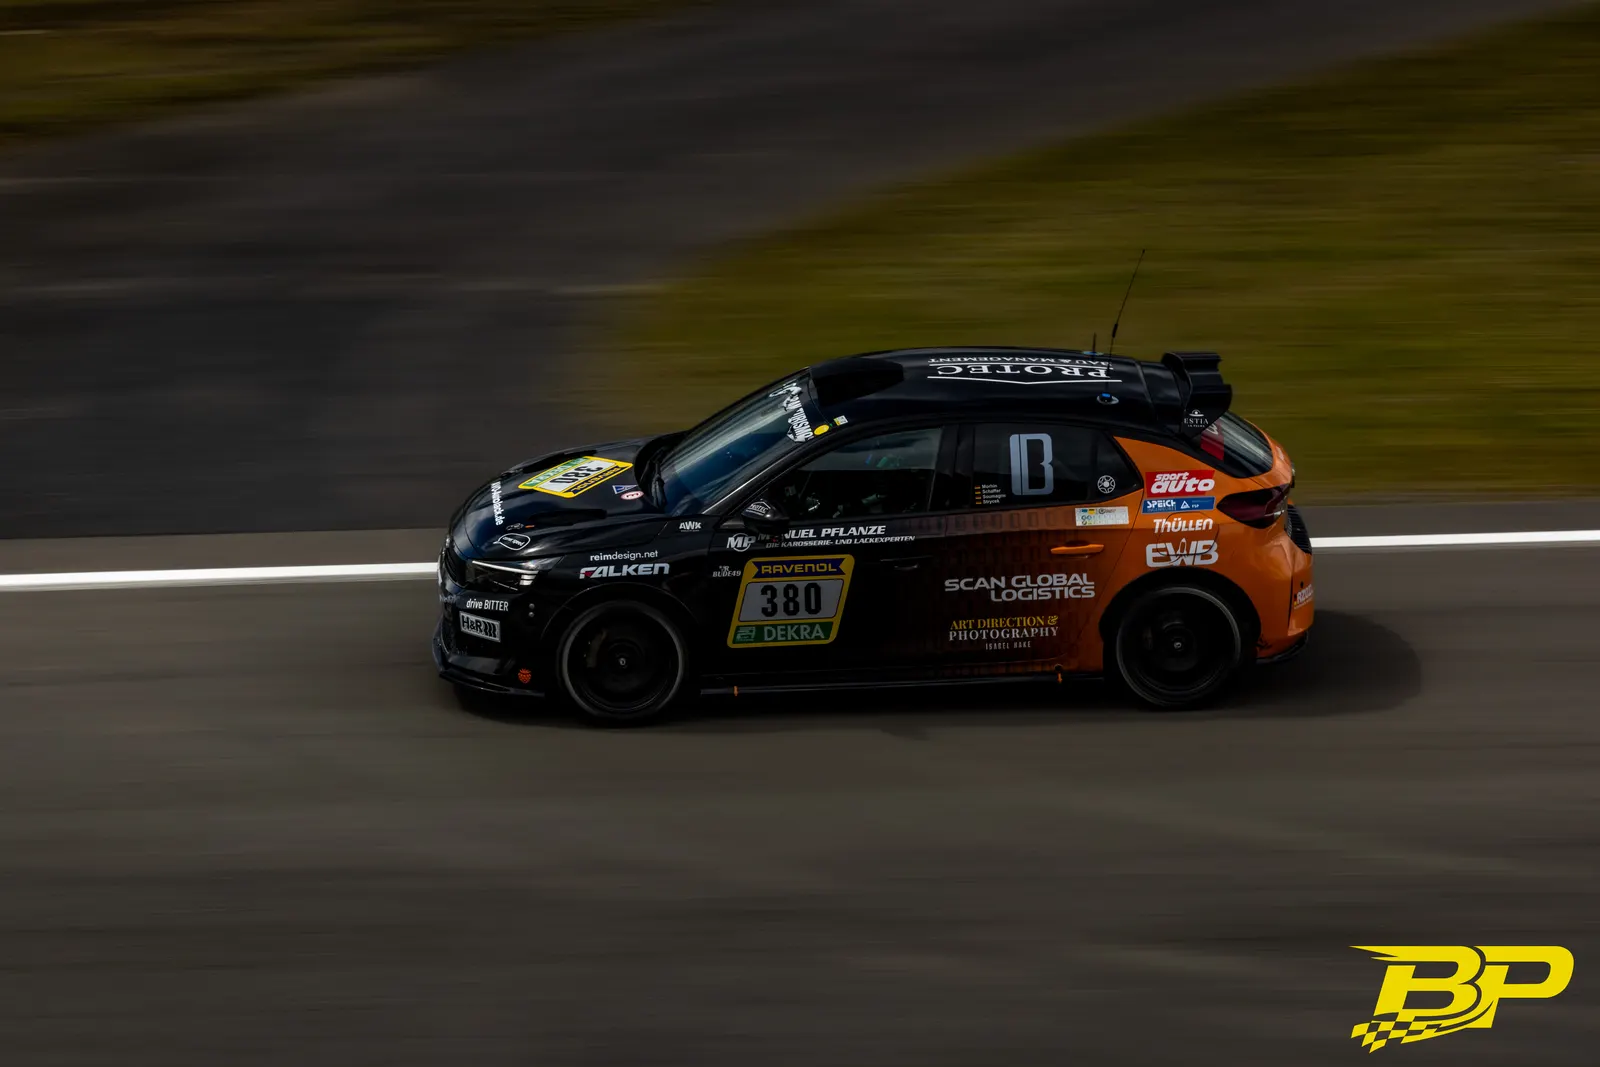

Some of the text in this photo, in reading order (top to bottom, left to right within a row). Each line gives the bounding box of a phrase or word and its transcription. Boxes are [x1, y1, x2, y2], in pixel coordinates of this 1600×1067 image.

[937, 364, 1111, 378] PROTEC
[549, 465, 603, 484] 380
[1155, 472, 1190, 483] sport
[1151, 479, 1215, 494] auto
[679, 521, 701, 530] AWK
[821, 525, 887, 537] PFLANZE
[726, 535, 756, 549] MP
[781, 539, 834, 548] KAROSSERIE-
[853, 535, 916, 544] LACKEXPERTEN
[590, 550, 659, 562] reimdesign.net
[1145, 539, 1219, 567] EWB
[579, 563, 670, 579] FALKEN
[761, 562, 837, 575] RAVENOL
[944, 573, 1095, 592] SCAN GLOBAL
[761, 583, 822, 617] 380
[990, 586, 1096, 602] LOGISTICS
[466, 598, 484, 609] drive
[484, 600, 509, 612] BITTER
[462, 617, 484, 633] H&R
[950, 615, 1059, 631] ART DIRECTION &
[763, 623, 825, 642] DEKRA
[949, 627, 1059, 642] PHOTOGRAPHY
